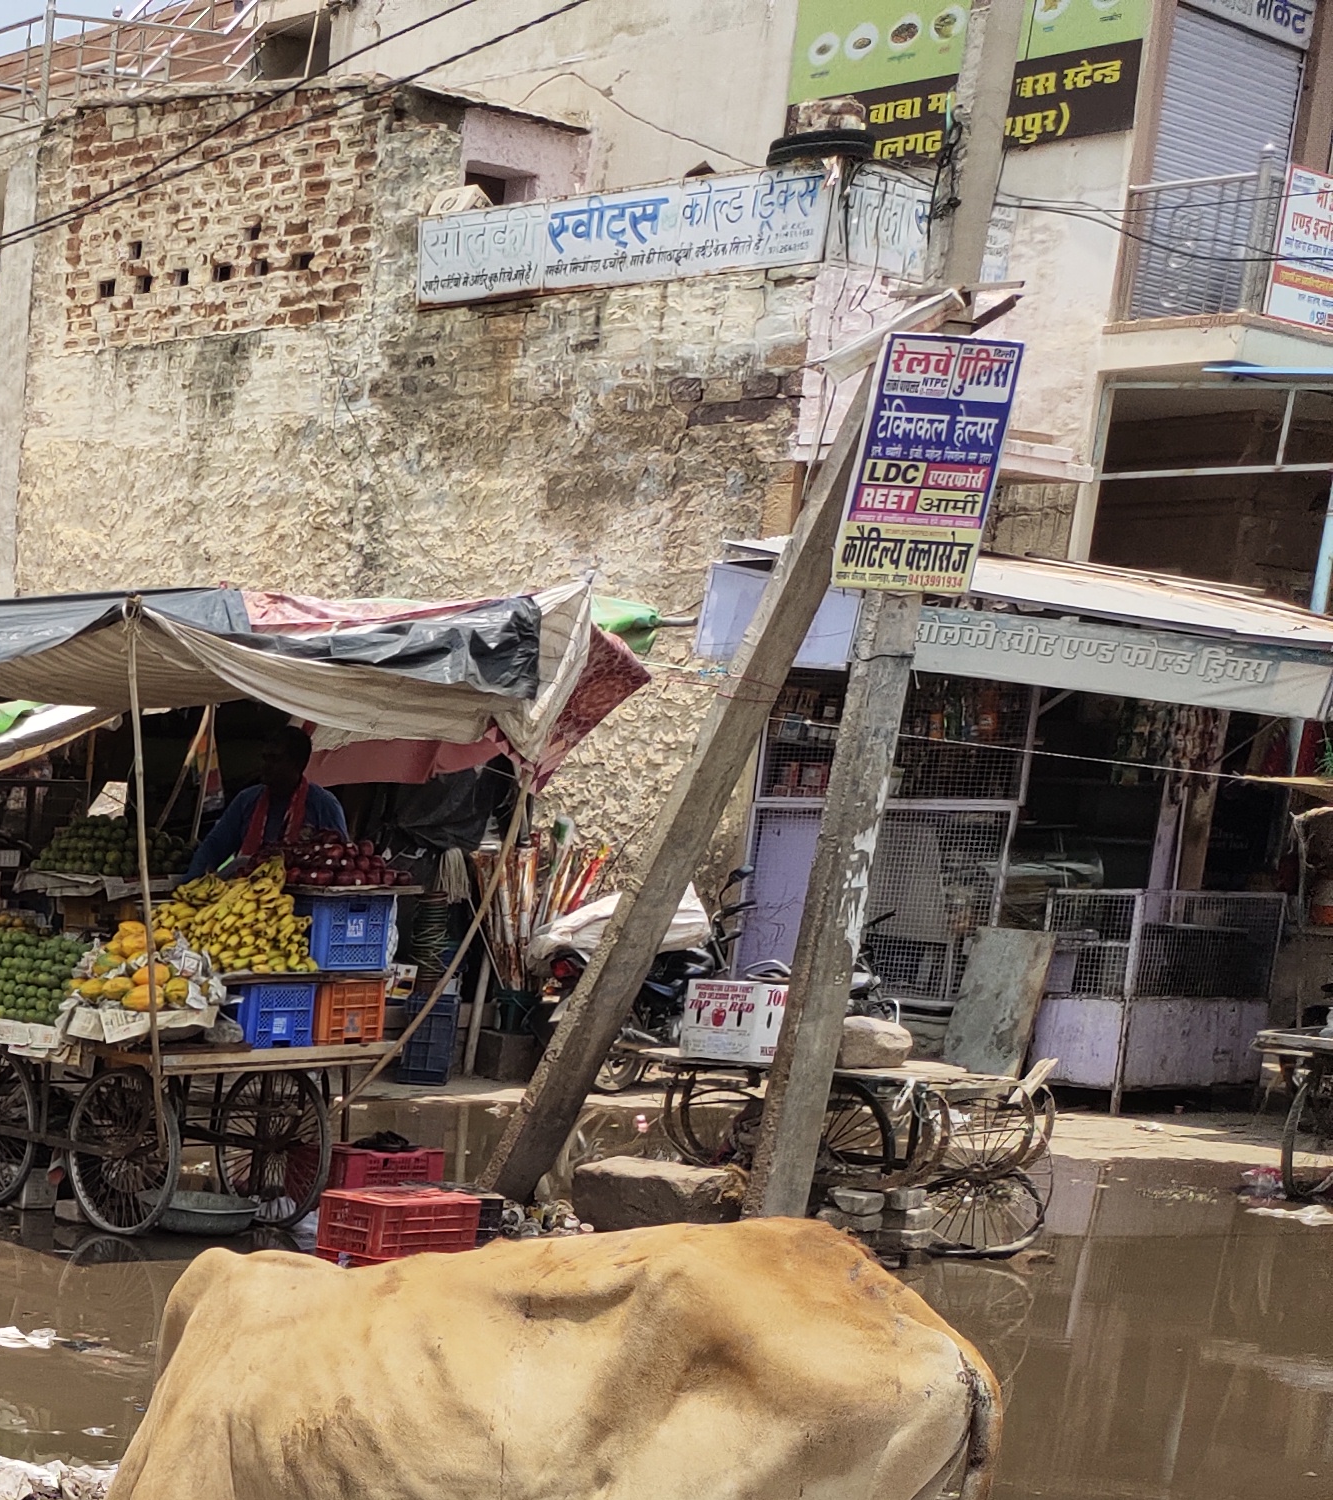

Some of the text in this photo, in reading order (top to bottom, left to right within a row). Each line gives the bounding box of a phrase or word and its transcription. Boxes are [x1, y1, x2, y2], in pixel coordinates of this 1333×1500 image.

[1063, 60, 1122, 91] स्टेन्ड
[548, 195, 669, 254] स्वीट्स
[682, 180, 750, 231] कोल्ड
[892, 343, 955, 376] रेलवे
[952, 348, 1014, 397] पुलिस
[922, 377, 949, 388] NTPC
[877, 398, 999, 448] टेक्निकल हेल्पर
[867, 462, 920, 484] LDC
[927, 468, 986, 488] एयरफोर्स
[860, 488, 914, 510] REET
[919, 494, 980, 514] आर्मी
[842, 525, 974, 574] कौटिल्य क्लासेज
[908, 574, 963, 588] 9413991934
[1059, 636, 1119, 664] एण्ड
[1120, 640, 1196, 674] कोल्ड
[1197, 646, 1273, 683] ड्रिंक्स
[688, 998, 755, 1013] TOP RED
